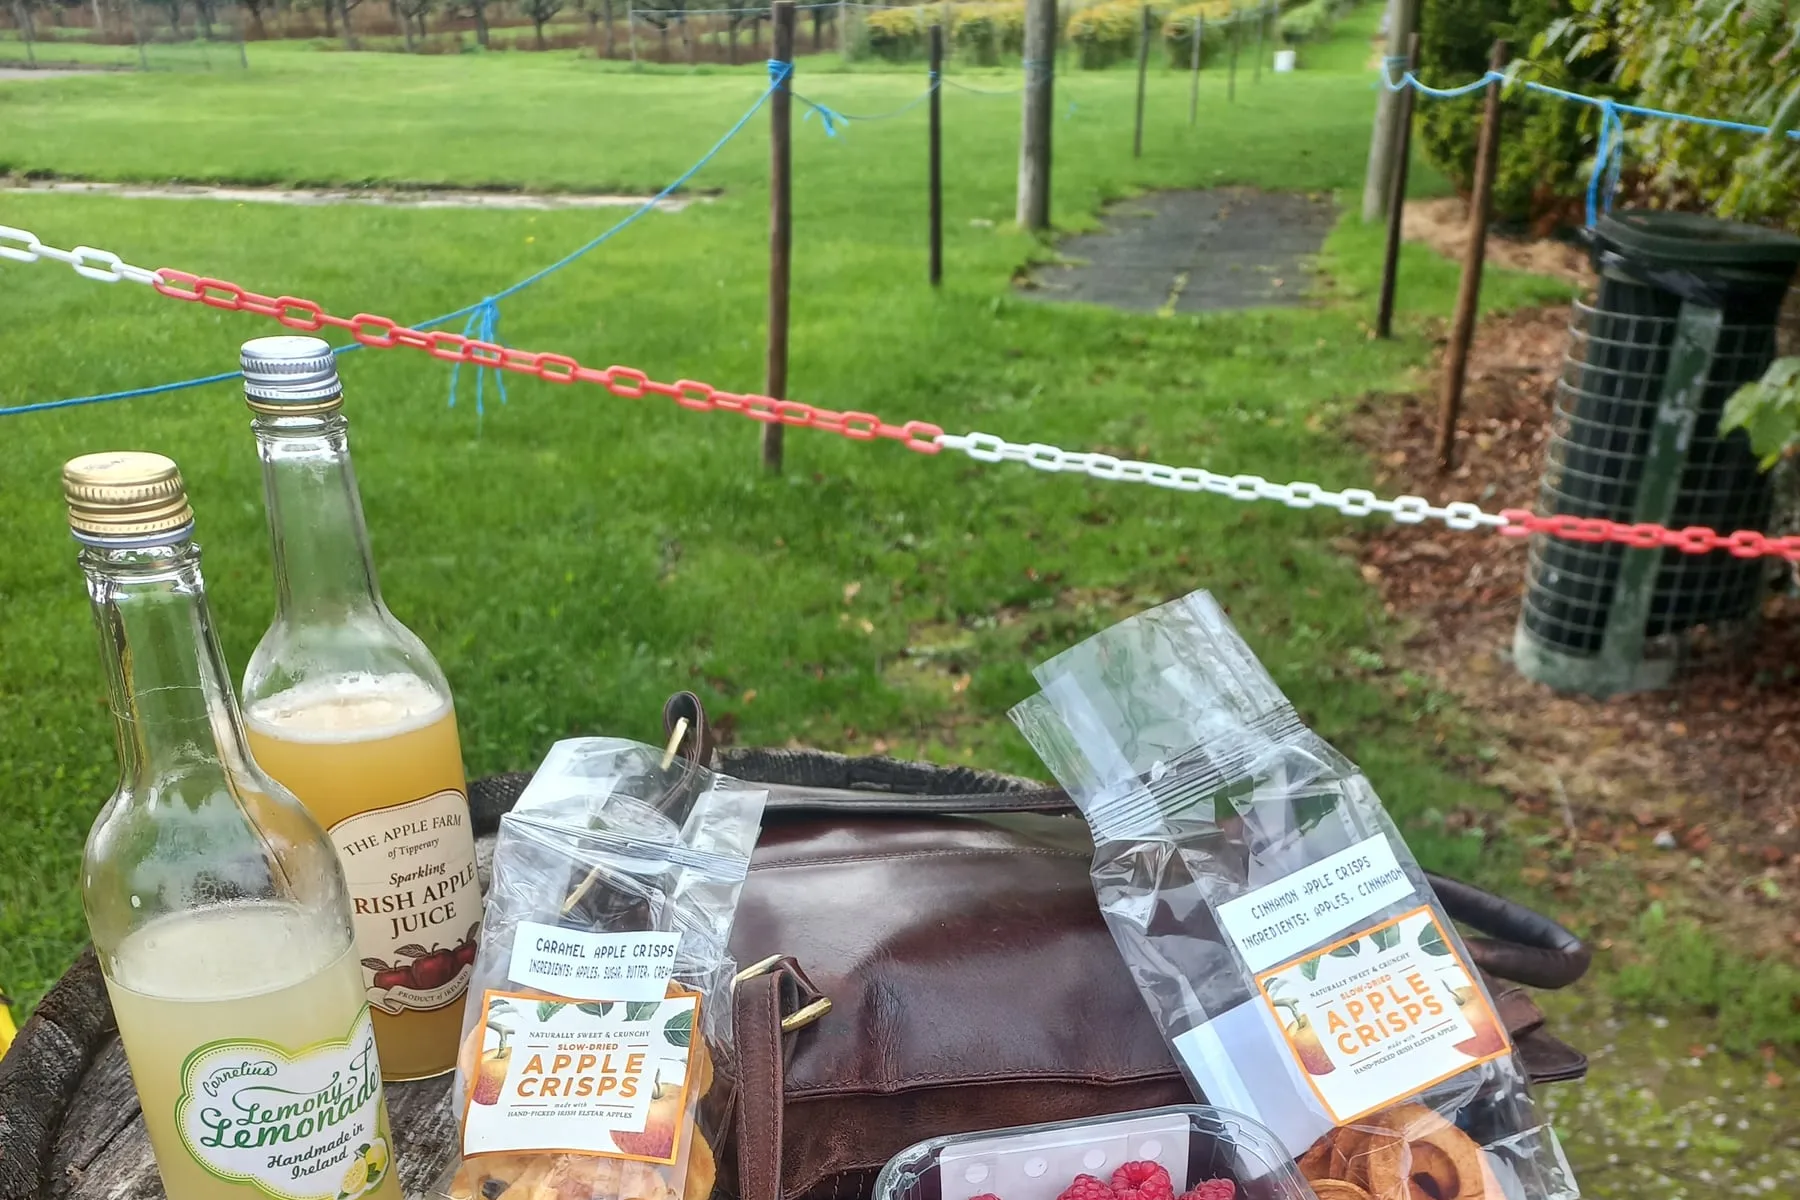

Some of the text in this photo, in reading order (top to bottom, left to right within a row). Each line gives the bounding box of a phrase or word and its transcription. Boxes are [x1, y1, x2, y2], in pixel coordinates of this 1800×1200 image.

[343, 814, 461, 857] THE APPLE FARM
[387, 838, 440, 859] of Tipperary
[353, 862, 475, 914] RISH APPLE
[389, 862, 446, 887] Sparkling
[1251, 856, 1371, 920] CINNAMON APPLE CRISPS
[391, 901, 457, 939] JUICE
[1241, 867, 1405, 950] INGREDIENTS: APPLES, CINNAMON
[536, 938, 674, 959] CARAMEL APPLE CRISPS
[529, 958, 573, 977] INGREDIENTS:
[1310, 952, 1411, 999] NATURALLY SWEET & CRUNCHY
[398, 970, 469, 1001] PRODUCT of IRELAND
[1327, 972, 1430, 1034] APPLE
[1340, 974, 1392, 1001] SLOW-DRIED
[528, 1030, 651, 1039] NATURALLY SWEET & CRUNCHY
[1337, 994, 1443, 1055] CRISPS
[1387, 1034, 1416, 1050] made with
[521, 1053, 646, 1075] APPLE
[557, 1043, 619, 1051] SLOW-DRIED
[1353, 1053, 1396, 1075] HAND-PICKED
[1396, 1044, 1414, 1056] IRISH
[1437, 1024, 1459, 1037] APPLES
[200, 1037, 380, 1148] Lemonade
[202, 1061, 277, 1097] Cornelius
[517, 1076, 639, 1098] CRISPS
[233, 1071, 355, 1125] Lemony
[507, 1110, 556, 1118] HAND-PICKED
[578, 1110, 604, 1118] ELSTAR
[606, 1111, 633, 1119] APPLES
[267, 1123, 365, 1169] Handmade in
[291, 1145, 348, 1180] Ireland
